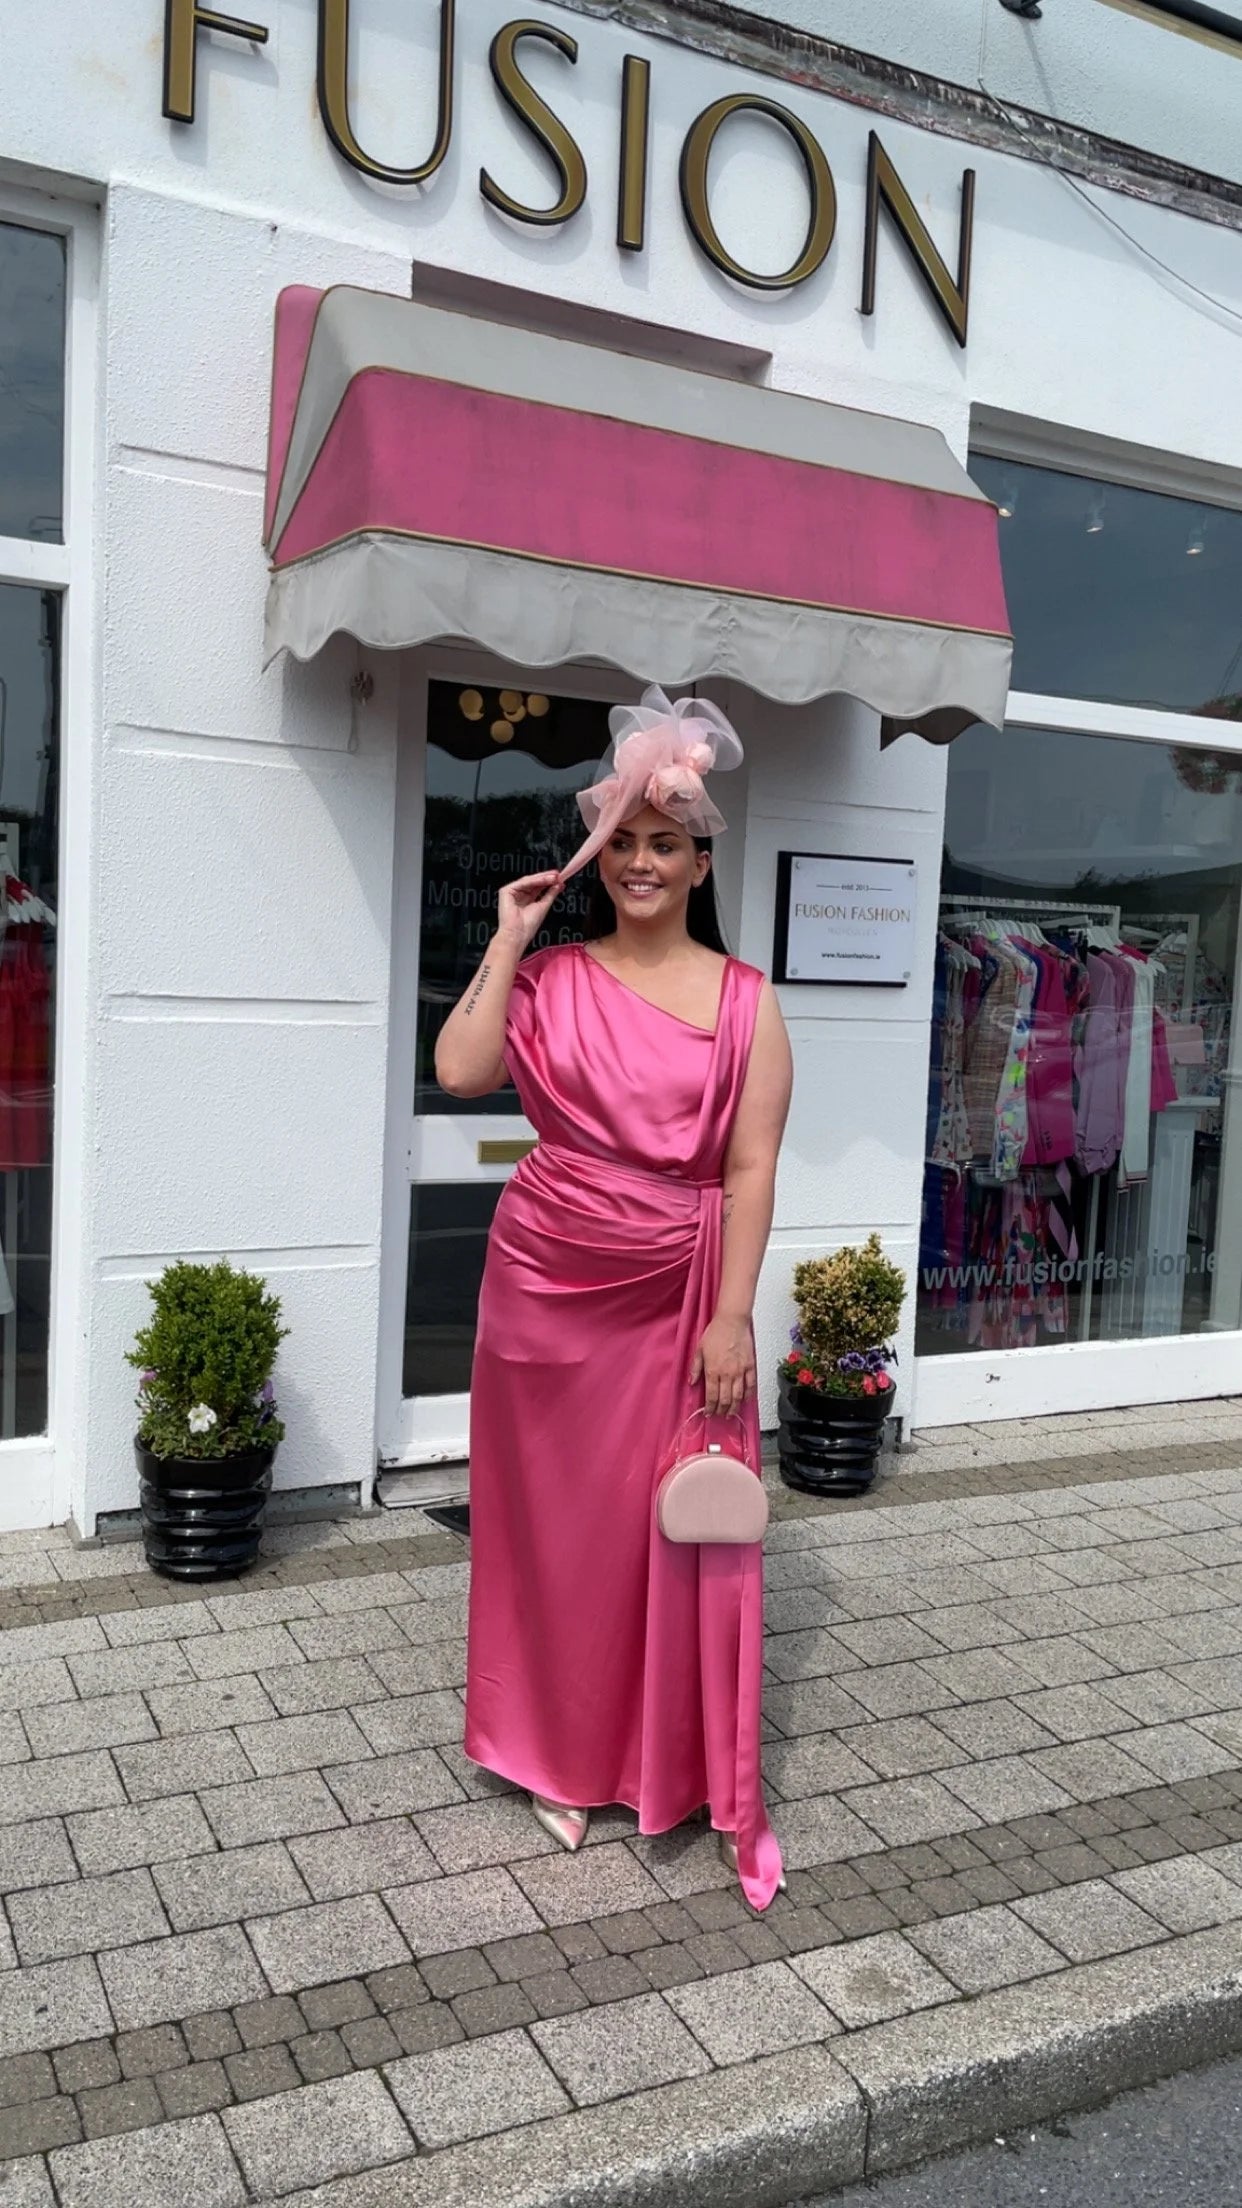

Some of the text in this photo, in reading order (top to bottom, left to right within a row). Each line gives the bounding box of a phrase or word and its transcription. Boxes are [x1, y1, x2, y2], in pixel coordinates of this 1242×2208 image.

[162, 0, 974, 348] FUSION
[458, 843, 548, 875] Opening
[795, 903, 911, 923] FUSION FASHION
[922, 1245, 1218, 1291] www.fusionfashion.ie
